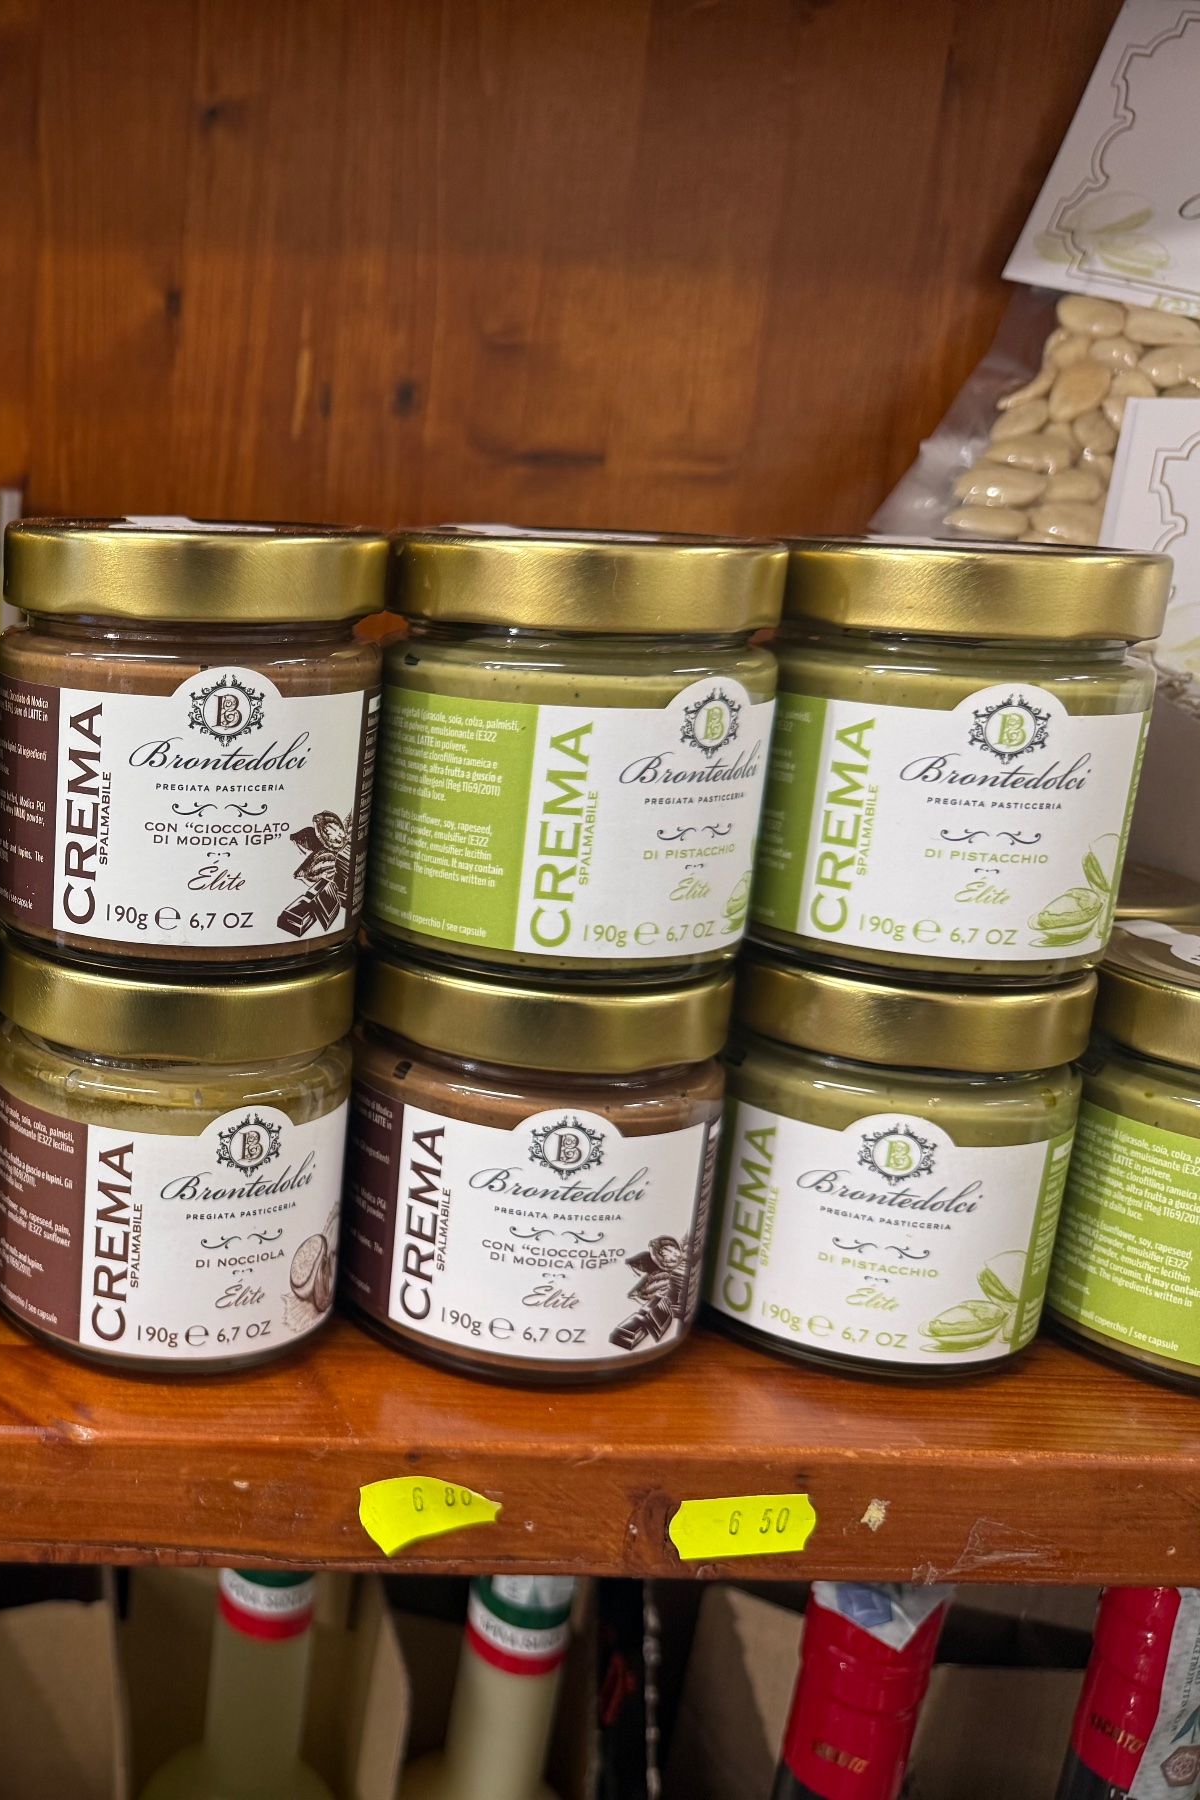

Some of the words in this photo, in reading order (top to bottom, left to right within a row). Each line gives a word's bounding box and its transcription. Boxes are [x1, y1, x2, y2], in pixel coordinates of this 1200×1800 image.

[129, 732, 310, 771] Brontedolci
[619, 740, 762, 784] Brontedolci
[156, 783, 210, 792] PREGIATA
[216, 784, 285, 792] PASTICCERIA
[900, 753, 1092, 791] Brontedolci
[63, 702, 103, 925] CREMA
[644, 796, 694, 805] PREGIATA
[698, 792, 745, 804] PASTICCERIA
[927, 797, 985, 808] PREGIATA
[991, 801, 1062, 810] PASTICCERIA
[98, 771, 112, 866] SPALMABILE
[145, 822, 178, 833] CON
[530, 721, 594, 948] CREMA
[810, 717, 876, 933] CREMA
[857, 784, 879, 876] SPALMABILE
[153, 835, 170, 844] DI
[177, 835, 238, 846] MODICA
[578, 791, 598, 886] SPALMABILE
[643, 849, 660, 860] DI
[665, 843, 735, 859] PISTACCHIO
[924, 849, 942, 859] DI
[950, 850, 1048, 865] PISTACCHIO
[187, 860, 245, 892] Élite
[106, 904, 148, 931] 190g
[189, 913, 216, 931] 6,7
[223, 912, 253, 929] OZ
[859, 915, 905, 942] 190g
[985, 928, 1019, 945] OZ
[583, 925, 628, 947] 190g
[693, 921, 715, 938] OZ
[160, 1150, 317, 1201] Brontedolci
[469, 1167, 652, 1203] Brontedolci
[796, 1168, 984, 1214] Brontedolci
[186, 1212, 236, 1220] PREGIATA
[240, 1201, 297, 1217] PASTICCERIA
[400, 1126, 446, 1321] CREMA
[494, 1206, 548, 1219] PREGIATA
[553, 1213, 622, 1222] PASTICCERIA
[722, 1126, 777, 1313] CREMA
[820, 1205, 874, 1223] PREGIATA
[879, 1217, 951, 1231] PASTICCERIA
[91, 1141, 134, 1342] CREMA
[435, 1188, 452, 1271] SPALMABILE
[482, 1239, 514, 1250] CON
[130, 1204, 143, 1288] SPALMABILE
[196, 1259, 210, 1268] DI
[217, 1248, 285, 1268] NOCCIOLA
[490, 1252, 506, 1261] DI
[512, 1255, 574, 1269] MODICA
[818, 1252, 835, 1262] DI
[842, 1256, 939, 1278] PISTACCHIO
[137, 1324, 178, 1348] 190g
[217, 1325, 239, 1344] 6,7
[246, 1319, 272, 1338] OZ
[442, 1307, 482, 1336] 190g
[522, 1326, 548, 1343] 6,7
[556, 1329, 586, 1343] OZ
[762, 1301, 802, 1332] 190g
[875, 1330, 907, 1348] OZ
[729, 1511, 741, 1535] 6
[759, 1507, 790, 1534] 50
